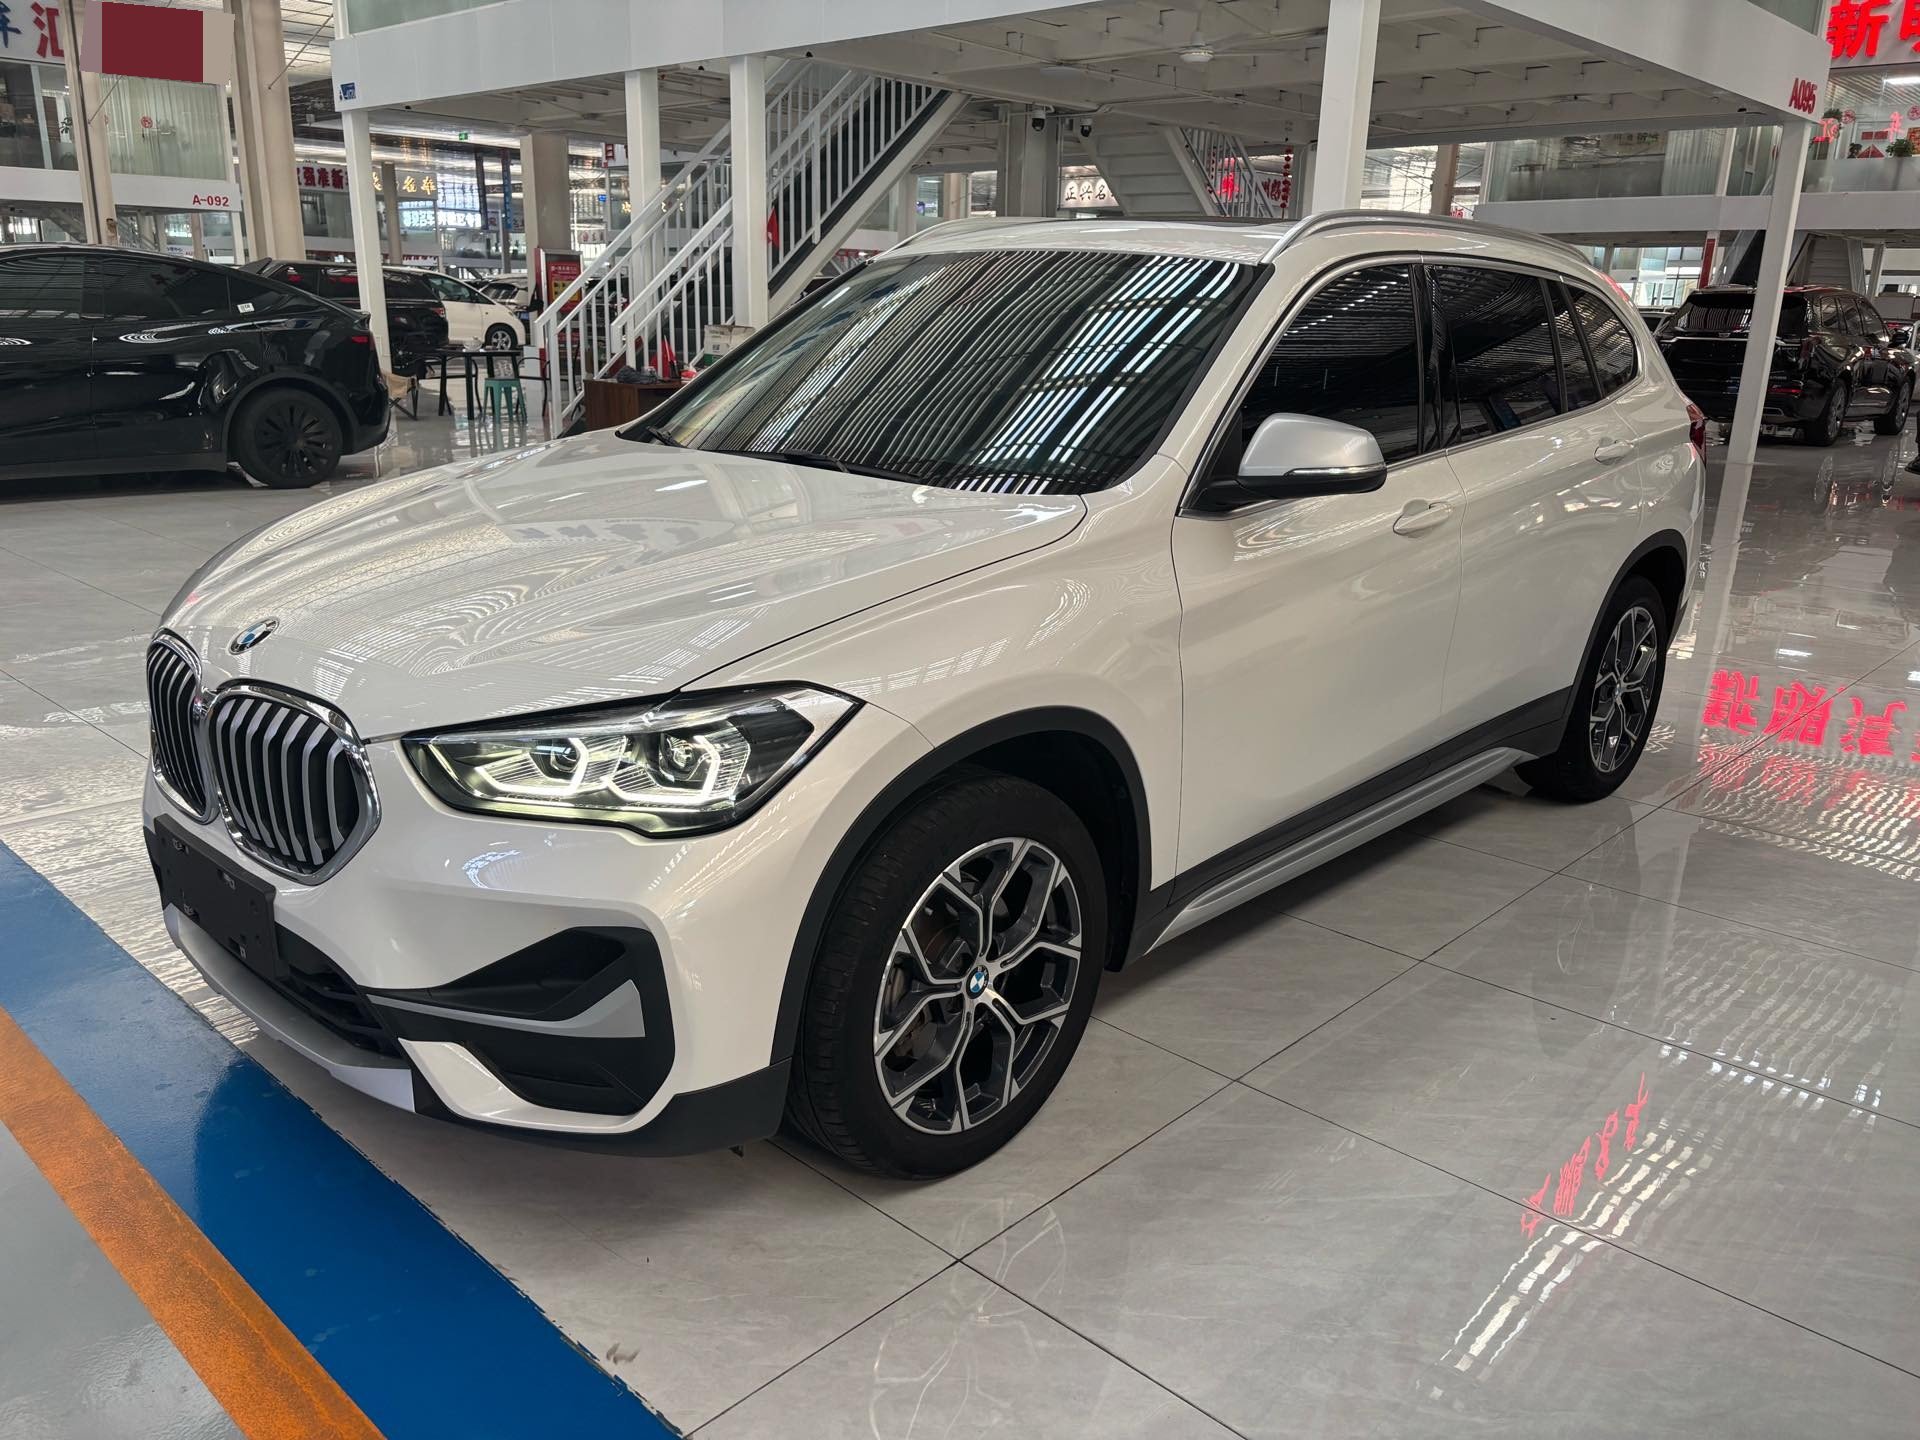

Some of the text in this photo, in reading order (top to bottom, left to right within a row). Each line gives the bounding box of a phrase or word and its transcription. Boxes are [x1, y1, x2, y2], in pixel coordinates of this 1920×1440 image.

[1788, 77, 1818, 115] A095
[192, 194, 230, 208] A-092
[1065, 184, 1114, 201] 正兴名
